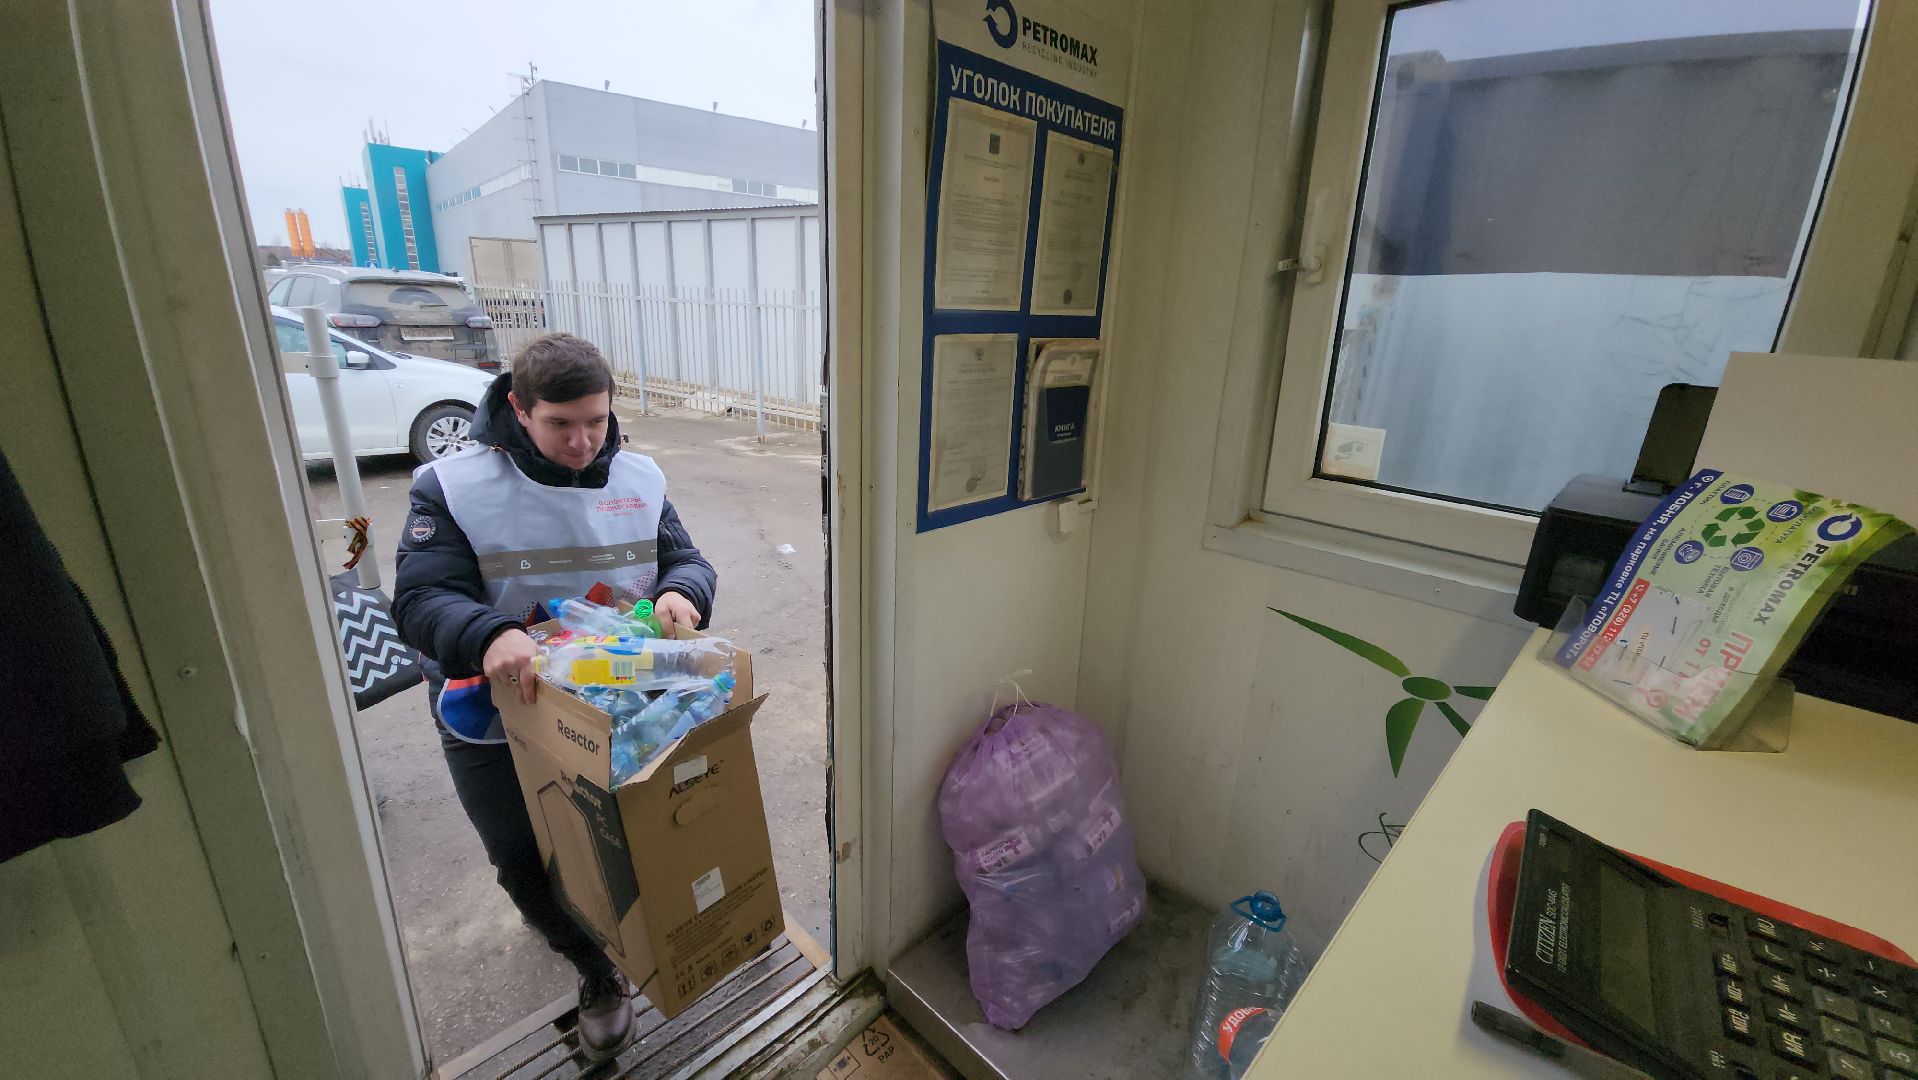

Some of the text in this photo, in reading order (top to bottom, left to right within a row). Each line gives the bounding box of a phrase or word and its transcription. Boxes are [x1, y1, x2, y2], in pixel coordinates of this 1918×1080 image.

[1022, 16, 1098, 66] PETROMAX
[1022, 42, 1098, 78] RECYCLING INDUSTRY
[950, 64, 1116, 141] УГОЛОК ПОКУПАТЕЛЯ
[1054, 423, 1075, 433] КНИГА
[1652, 491, 1693, 526] ЛОБНЯ,
[1643, 527, 1656, 540] на
[1615, 541, 1646, 589] парковке
[1697, 564, 1721, 595] ТЕХНИКА
[1629, 592, 1639, 604] +7
[1704, 566, 1729, 599] БЫТОВАЯ
[1753, 543, 1829, 626] PETROMAX
[1604, 591, 1620, 606] ТЦ
[1565, 605, 1608, 660] «ПОВОРОТ»
[1694, 638, 1711, 658] от
[557, 718, 600, 756] Reactor
[1536, 913, 1556, 965] CITIZEN
[1757, 917, 1776, 937] MU
[1772, 974, 1791, 994] M+
[1778, 1004, 1799, 1023] M-
[878, 1046, 895, 1063] PAP
[1783, 1032, 1805, 1057] MR
